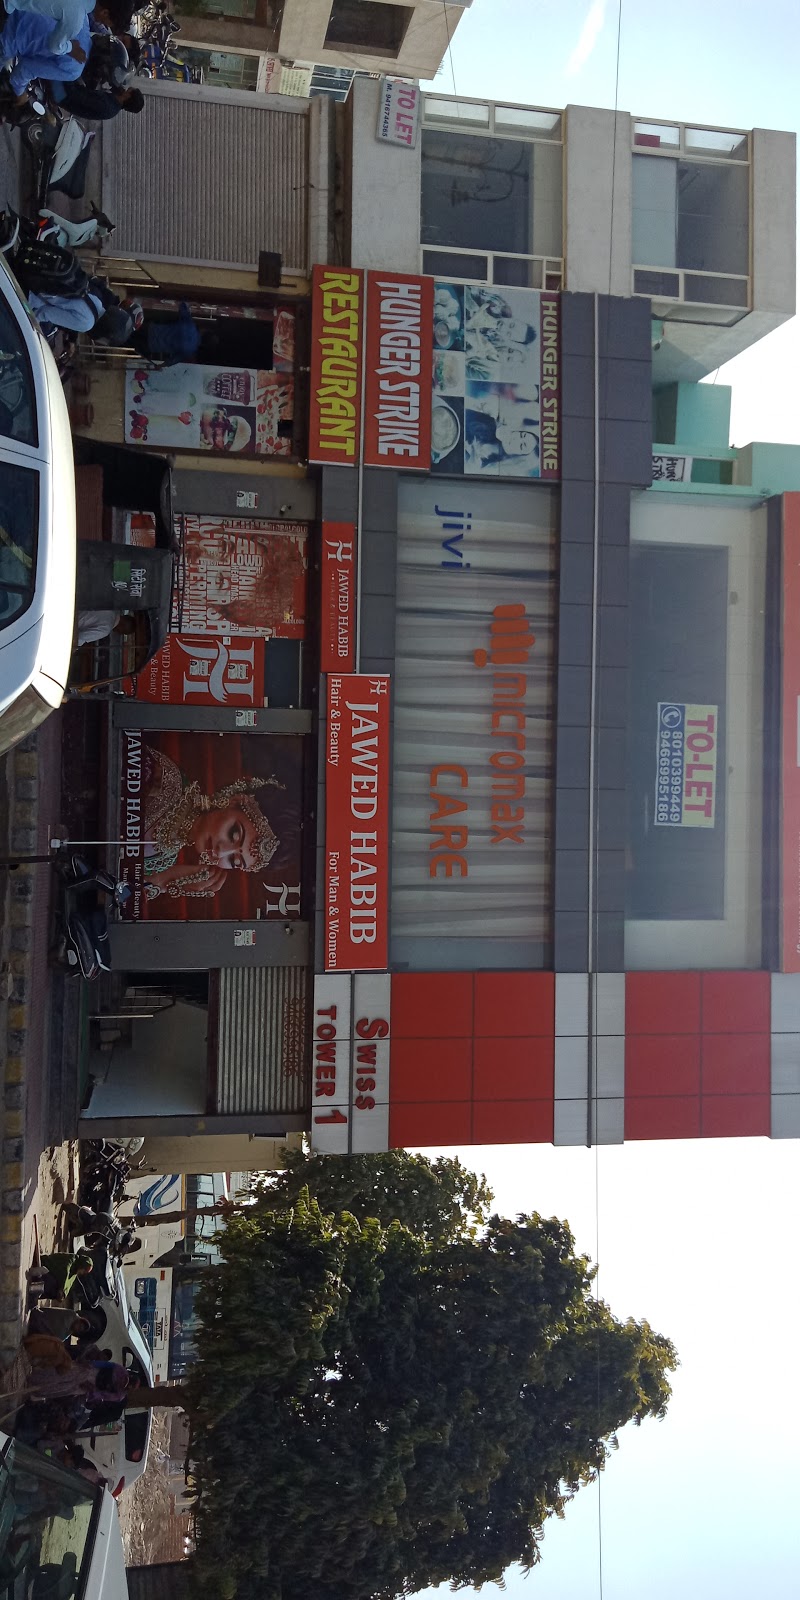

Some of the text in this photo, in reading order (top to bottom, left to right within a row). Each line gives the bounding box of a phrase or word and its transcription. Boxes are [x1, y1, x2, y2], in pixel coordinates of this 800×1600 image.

[382, 94, 391, 137] 9416744365
[395, 90, 416, 144] TO LET
[316, 271, 360, 456] RESTAURANT
[372, 281, 422, 457] HUNGER STRIKE
[540, 301, 558, 470] HUNGER STRIKE
[434, 504, 472, 570] jivi
[189, 564, 206, 630] PERMING
[336, 568, 349, 658] JAWED HABIB
[148, 668, 158, 696] Beauty
[160, 670, 170, 702] HABIB
[327, 678, 342, 766] Hair & Beauty
[124, 730, 142, 792] JAWED
[489, 672, 527, 844] micromax
[658, 730, 671, 822] 9466995186
[670, 731, 683, 822] 8010399449
[684, 715, 714, 817] TO-LET
[344, 701, 379, 944] JAWED HABIB
[429, 763, 469, 878] CARE
[132, 890, 142, 919] Beauty
[134, 863, 142, 882] Hair
[327, 852, 340, 968] For Man & Women
[314, 1005, 347, 1124] TOWER 1
